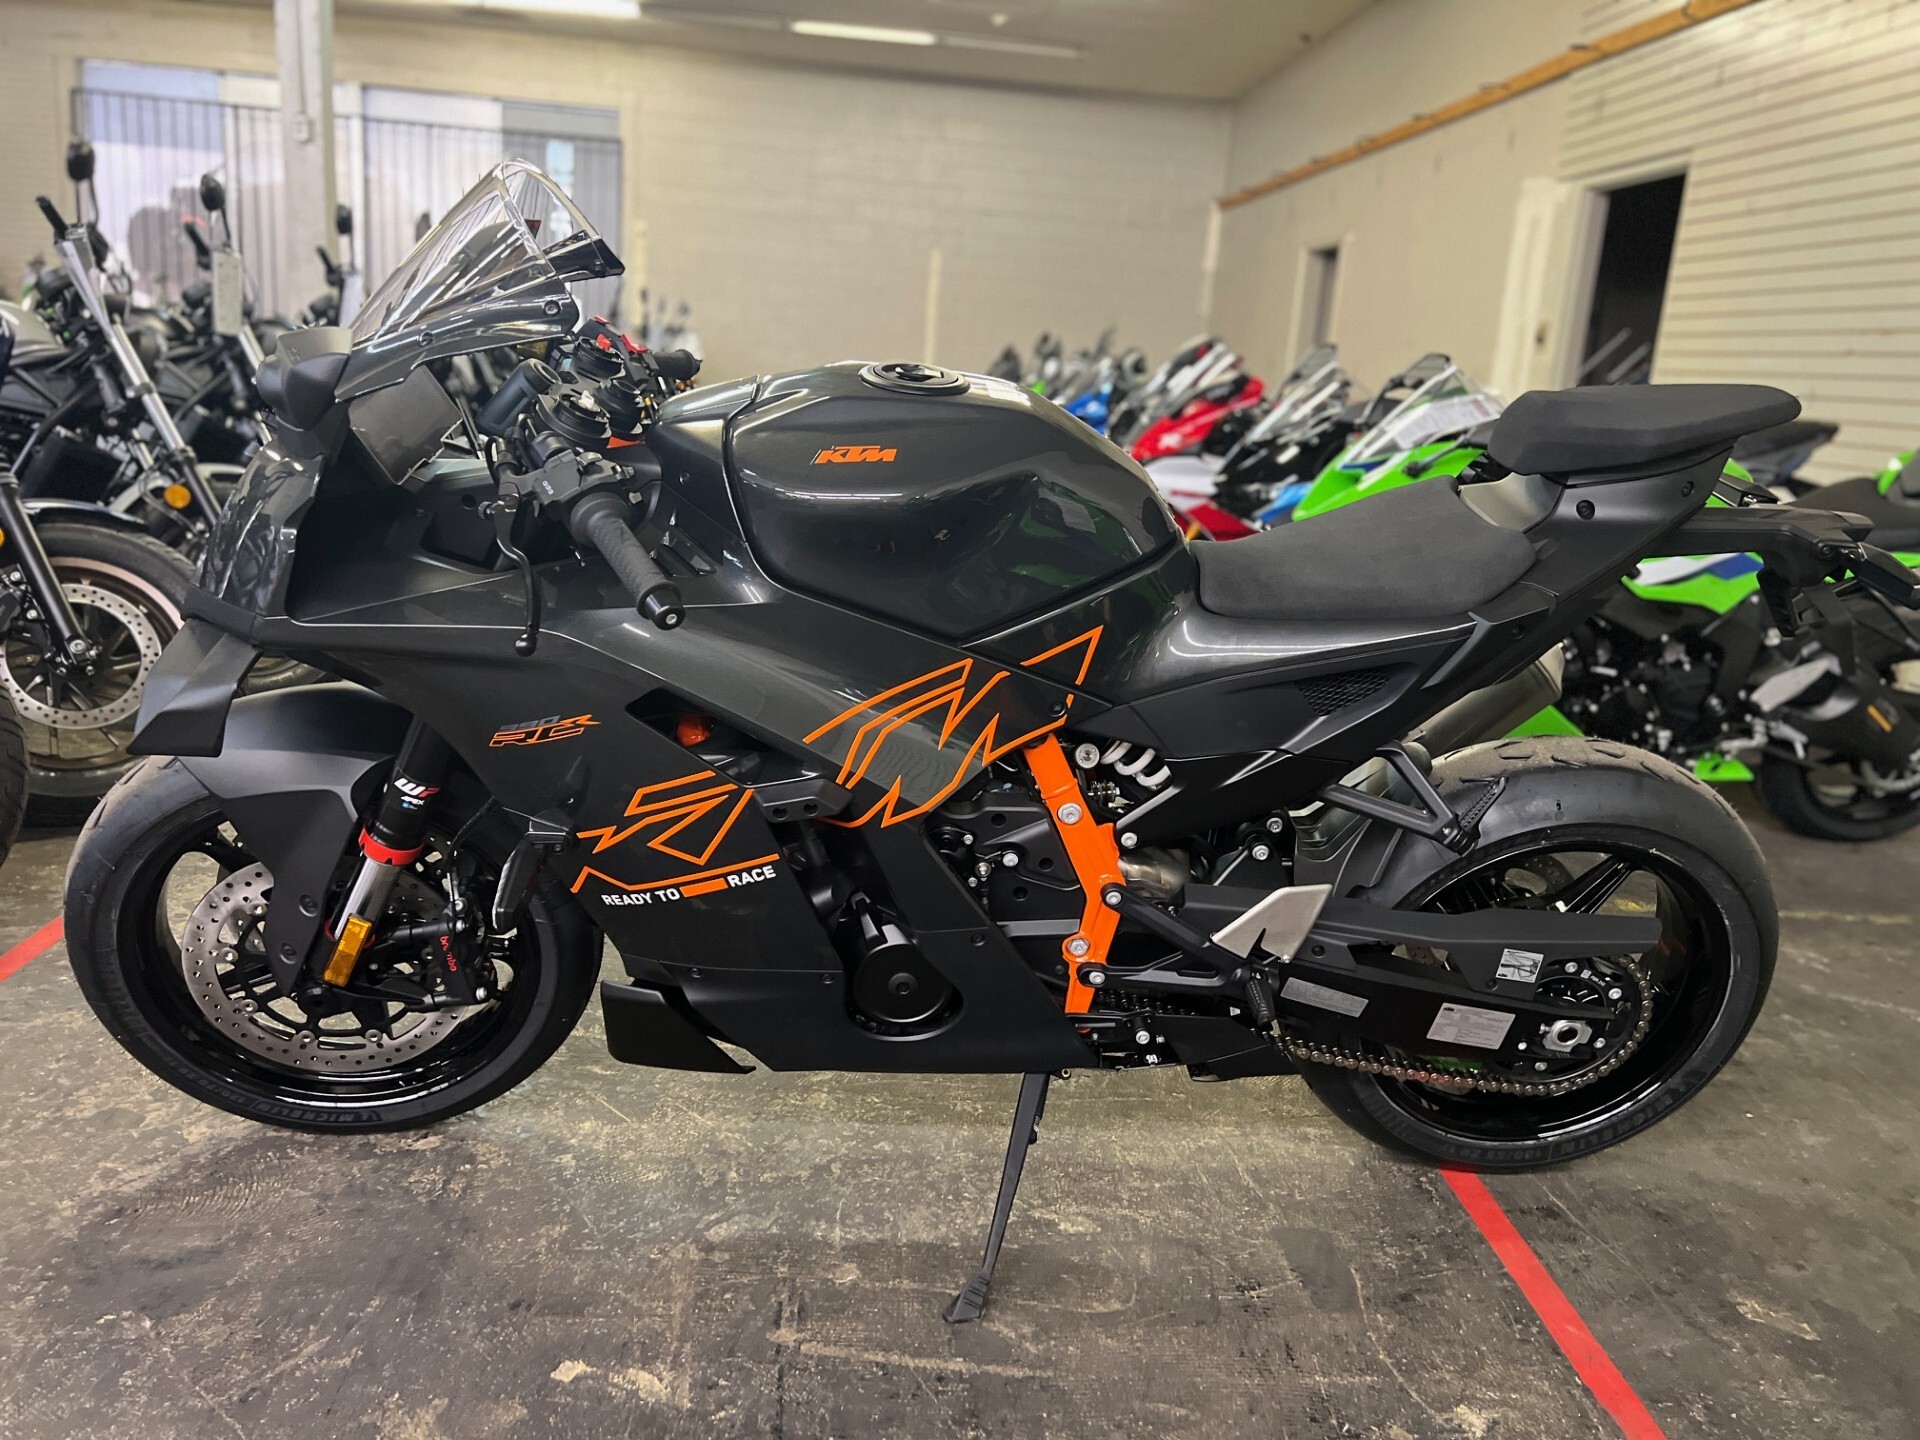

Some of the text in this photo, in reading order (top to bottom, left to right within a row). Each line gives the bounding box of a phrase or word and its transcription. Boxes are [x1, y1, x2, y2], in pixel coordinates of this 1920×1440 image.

[812, 445, 898, 465] KTM
[489, 724, 585, 747] RC
[393, 777, 441, 798] WP
[601, 864, 777, 907] READY TO RACE
[256, 1101, 355, 1122] MICHELIN
